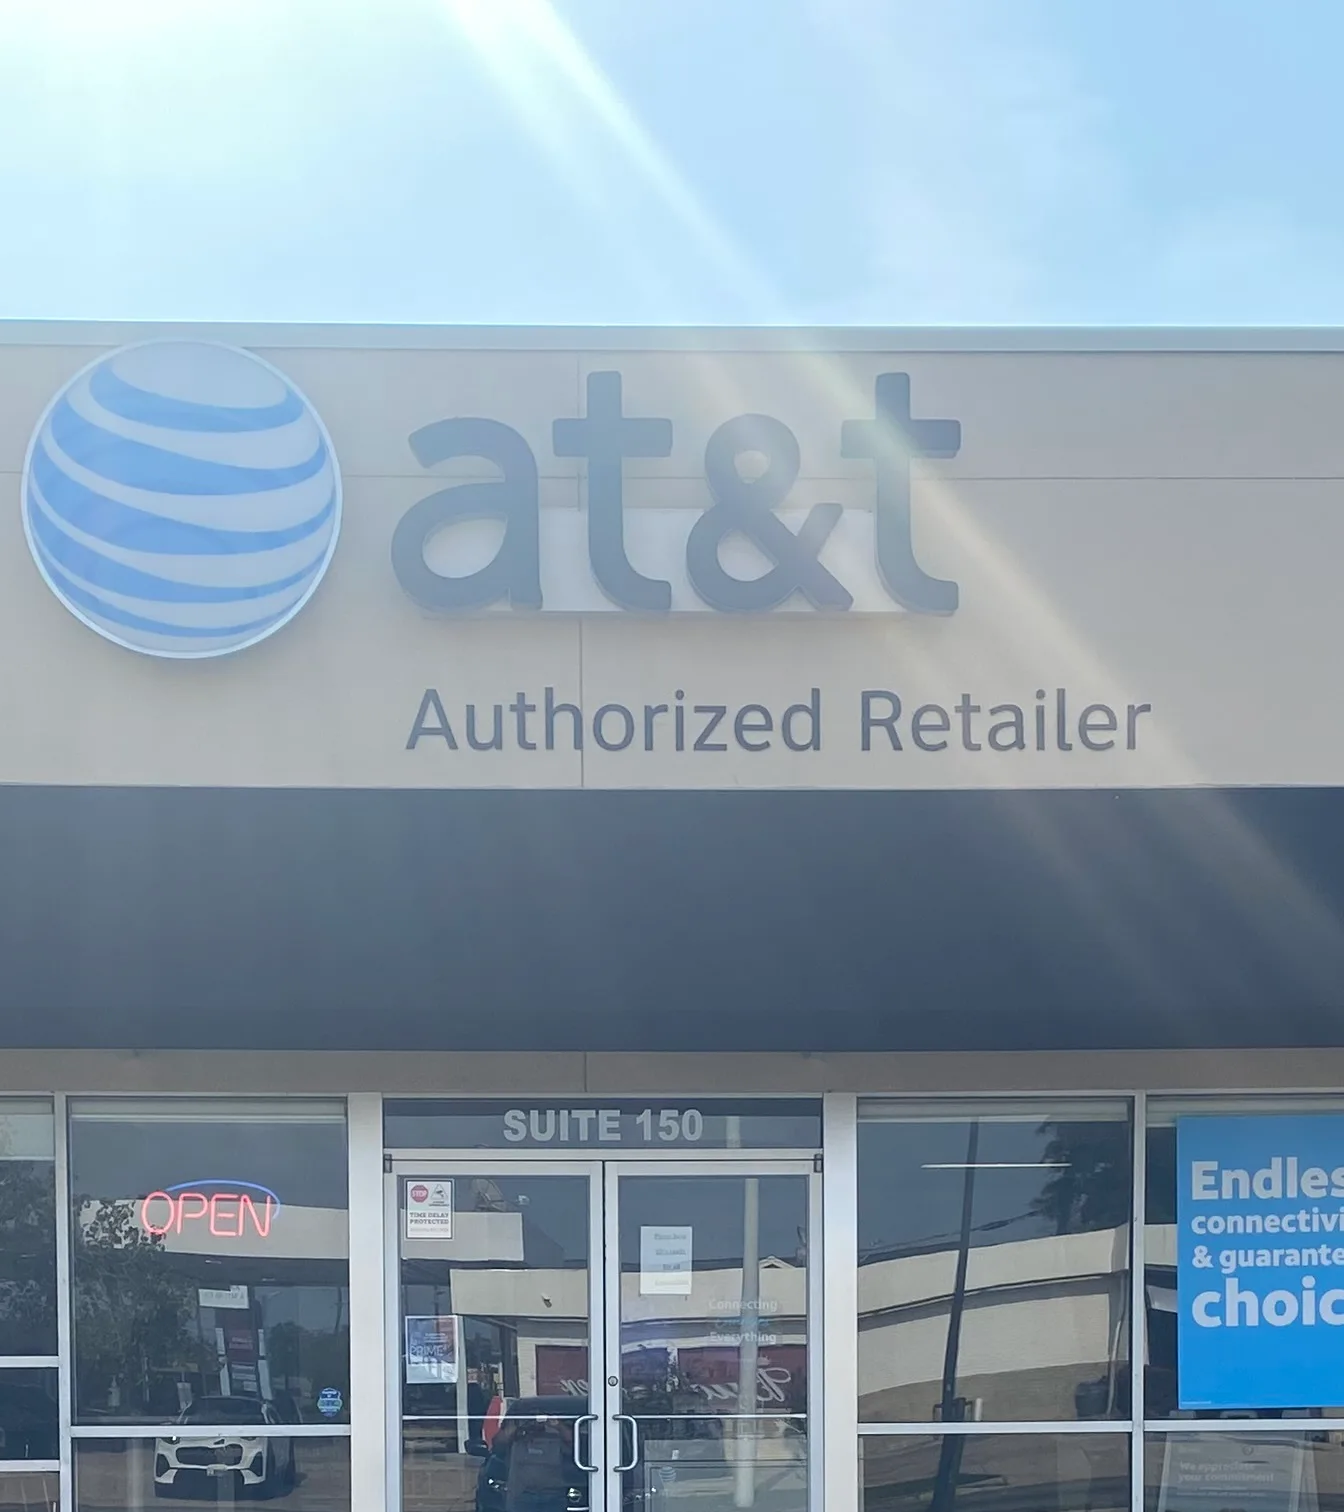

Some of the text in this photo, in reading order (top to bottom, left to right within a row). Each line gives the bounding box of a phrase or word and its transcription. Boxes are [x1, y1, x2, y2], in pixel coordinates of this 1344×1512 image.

[391, 370, 961, 616] at&t
[405, 687, 1153, 752] Authorized Retailer
[503, 1108, 703, 1142] SUITE 150
[141, 1191, 272, 1237] OPEN
[1191, 1245, 1214, 1268] &
[709, 1299, 778, 1311] Connecting
[709, 1331, 777, 1344] Everything
